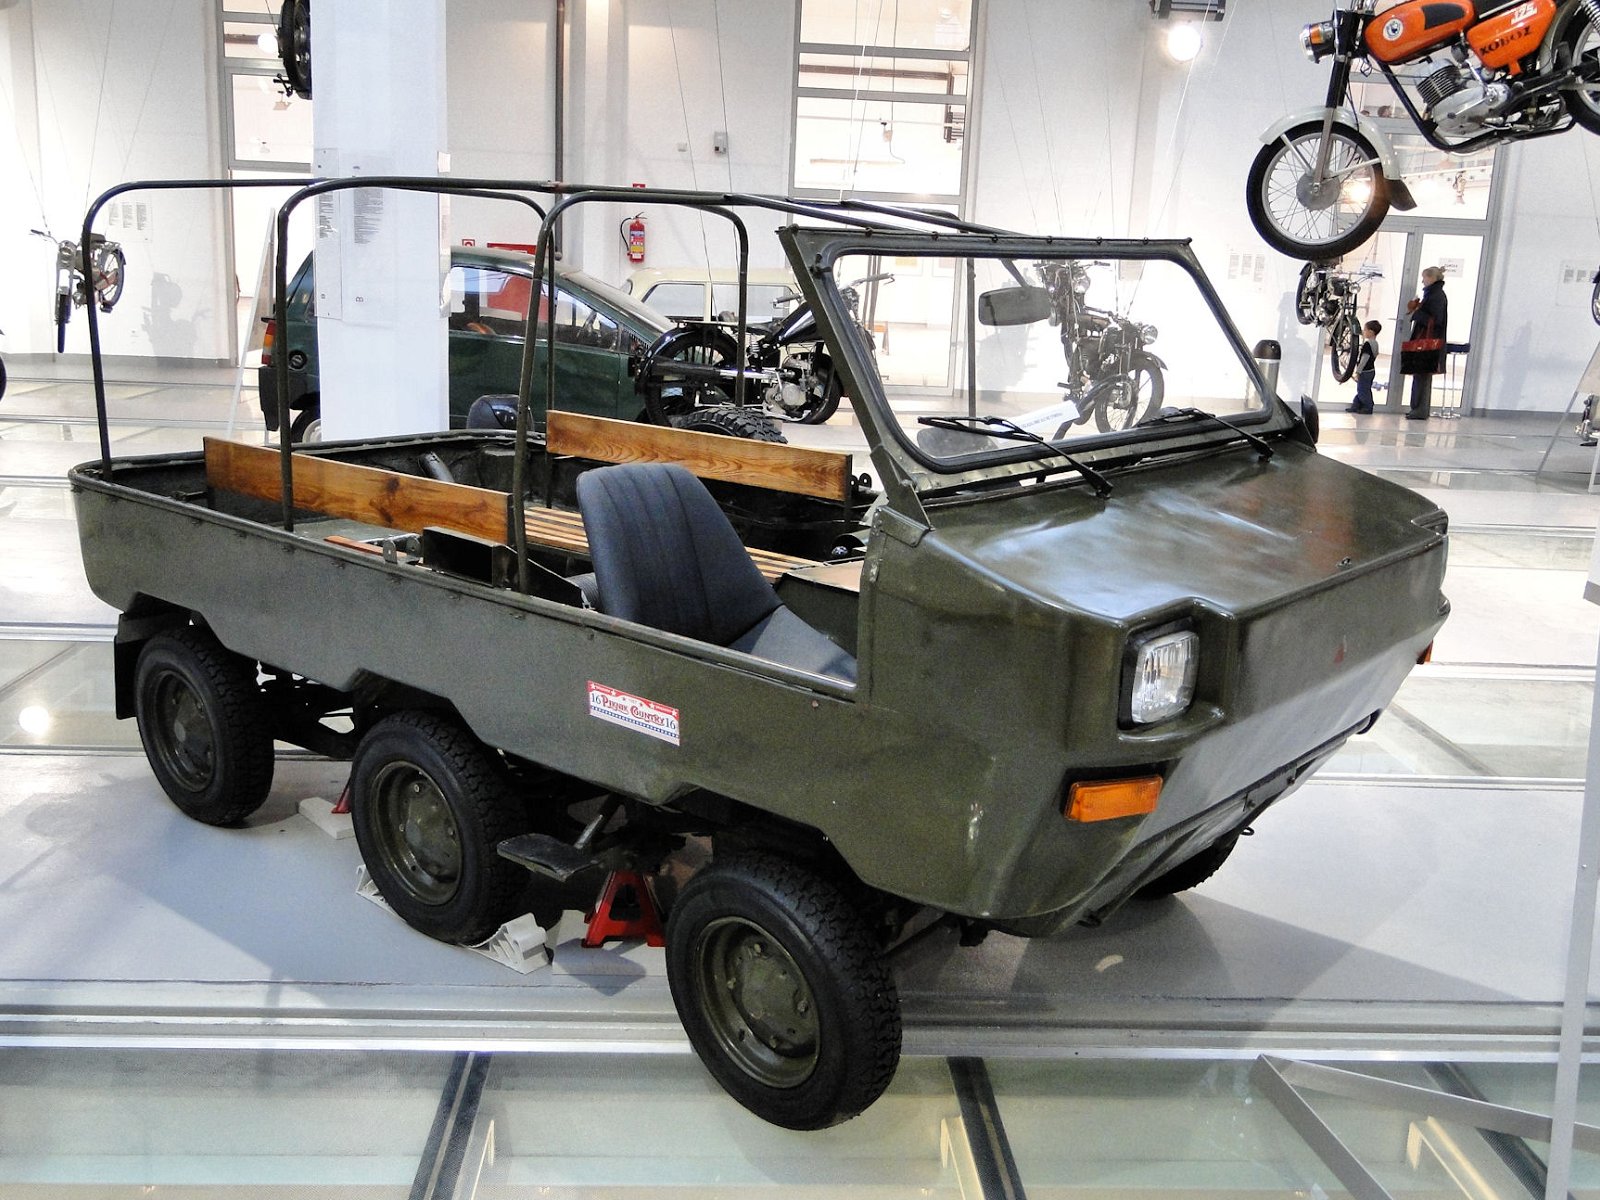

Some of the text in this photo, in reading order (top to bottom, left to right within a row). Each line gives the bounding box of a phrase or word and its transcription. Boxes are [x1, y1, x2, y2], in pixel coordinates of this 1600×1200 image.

[591, 693, 601, 705] 16
[630, 705, 665, 727] COUNTRY
[665, 717, 676, 730] 16
